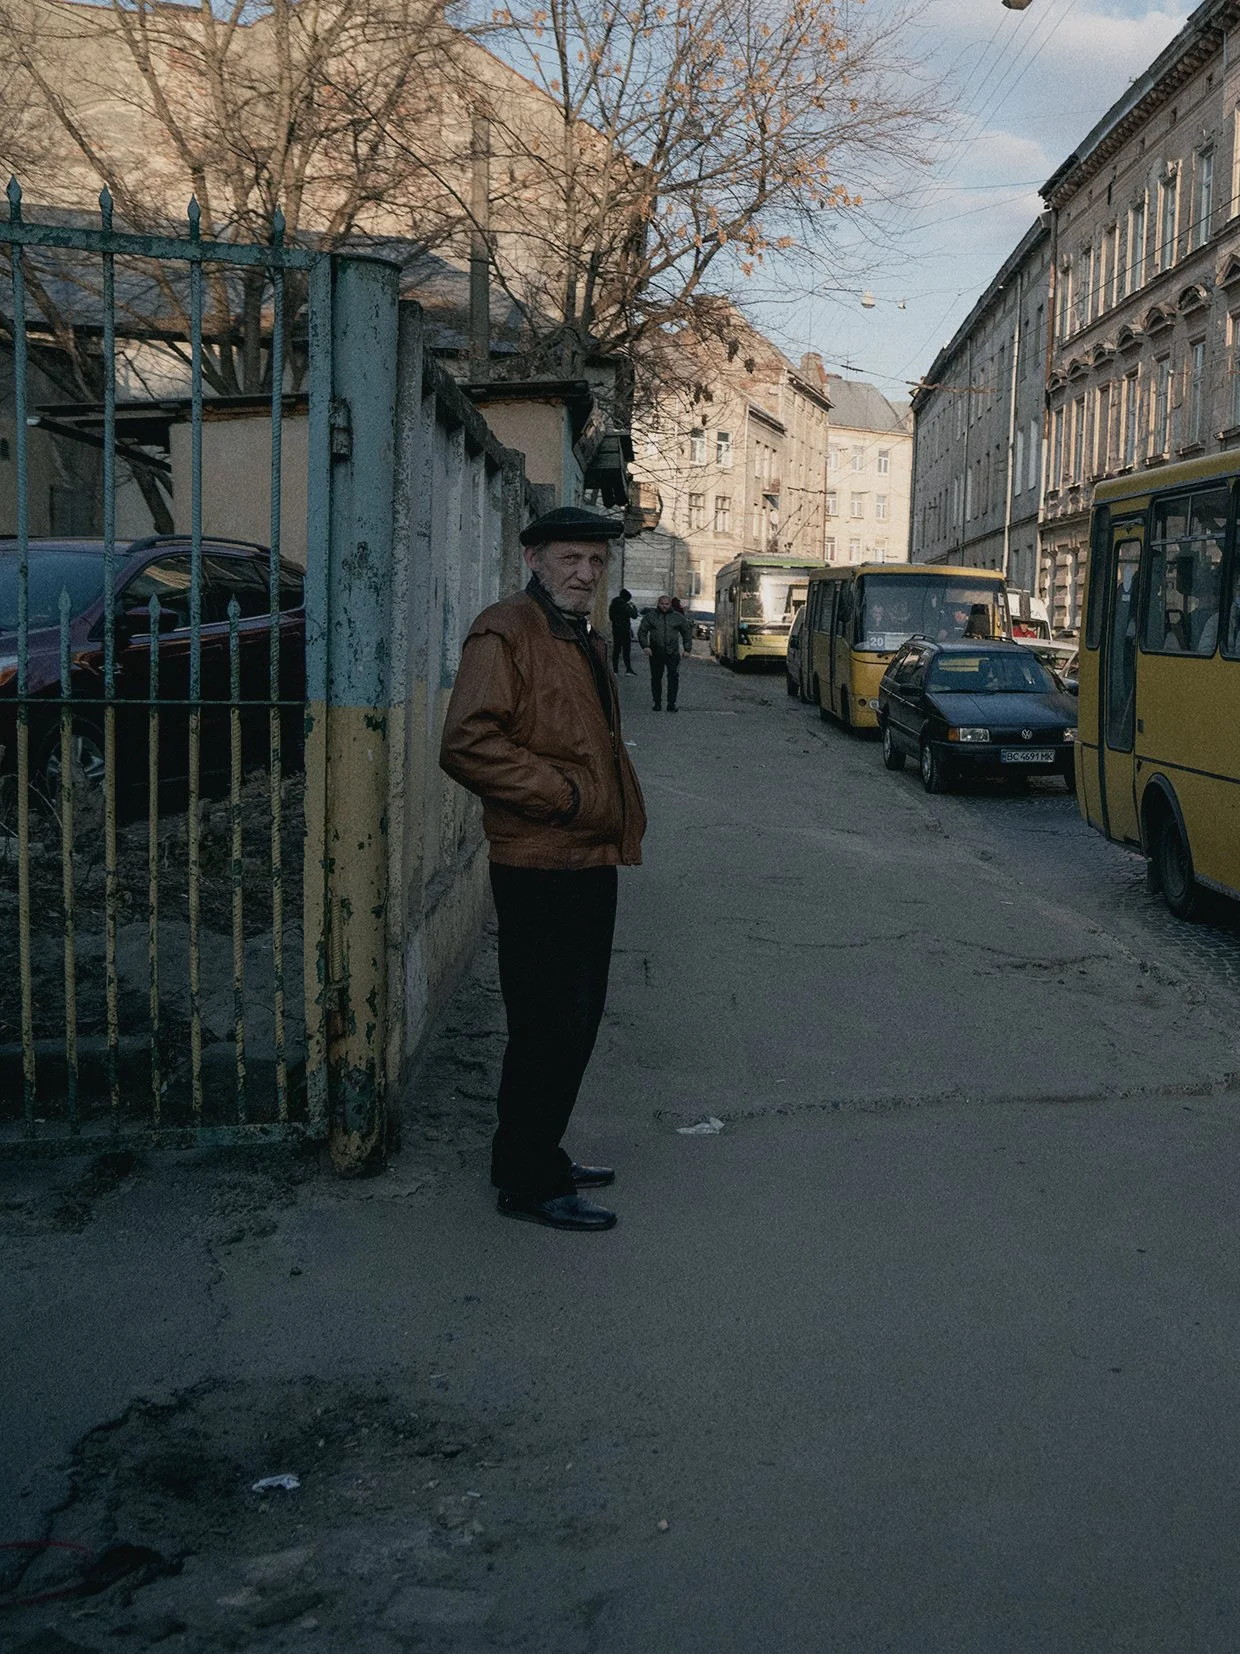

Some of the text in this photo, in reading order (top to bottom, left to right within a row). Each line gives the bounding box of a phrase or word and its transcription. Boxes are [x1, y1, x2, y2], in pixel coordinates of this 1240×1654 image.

[870, 637, 884, 647] 20
[1007, 752, 1053, 761] BC 4691 MK
